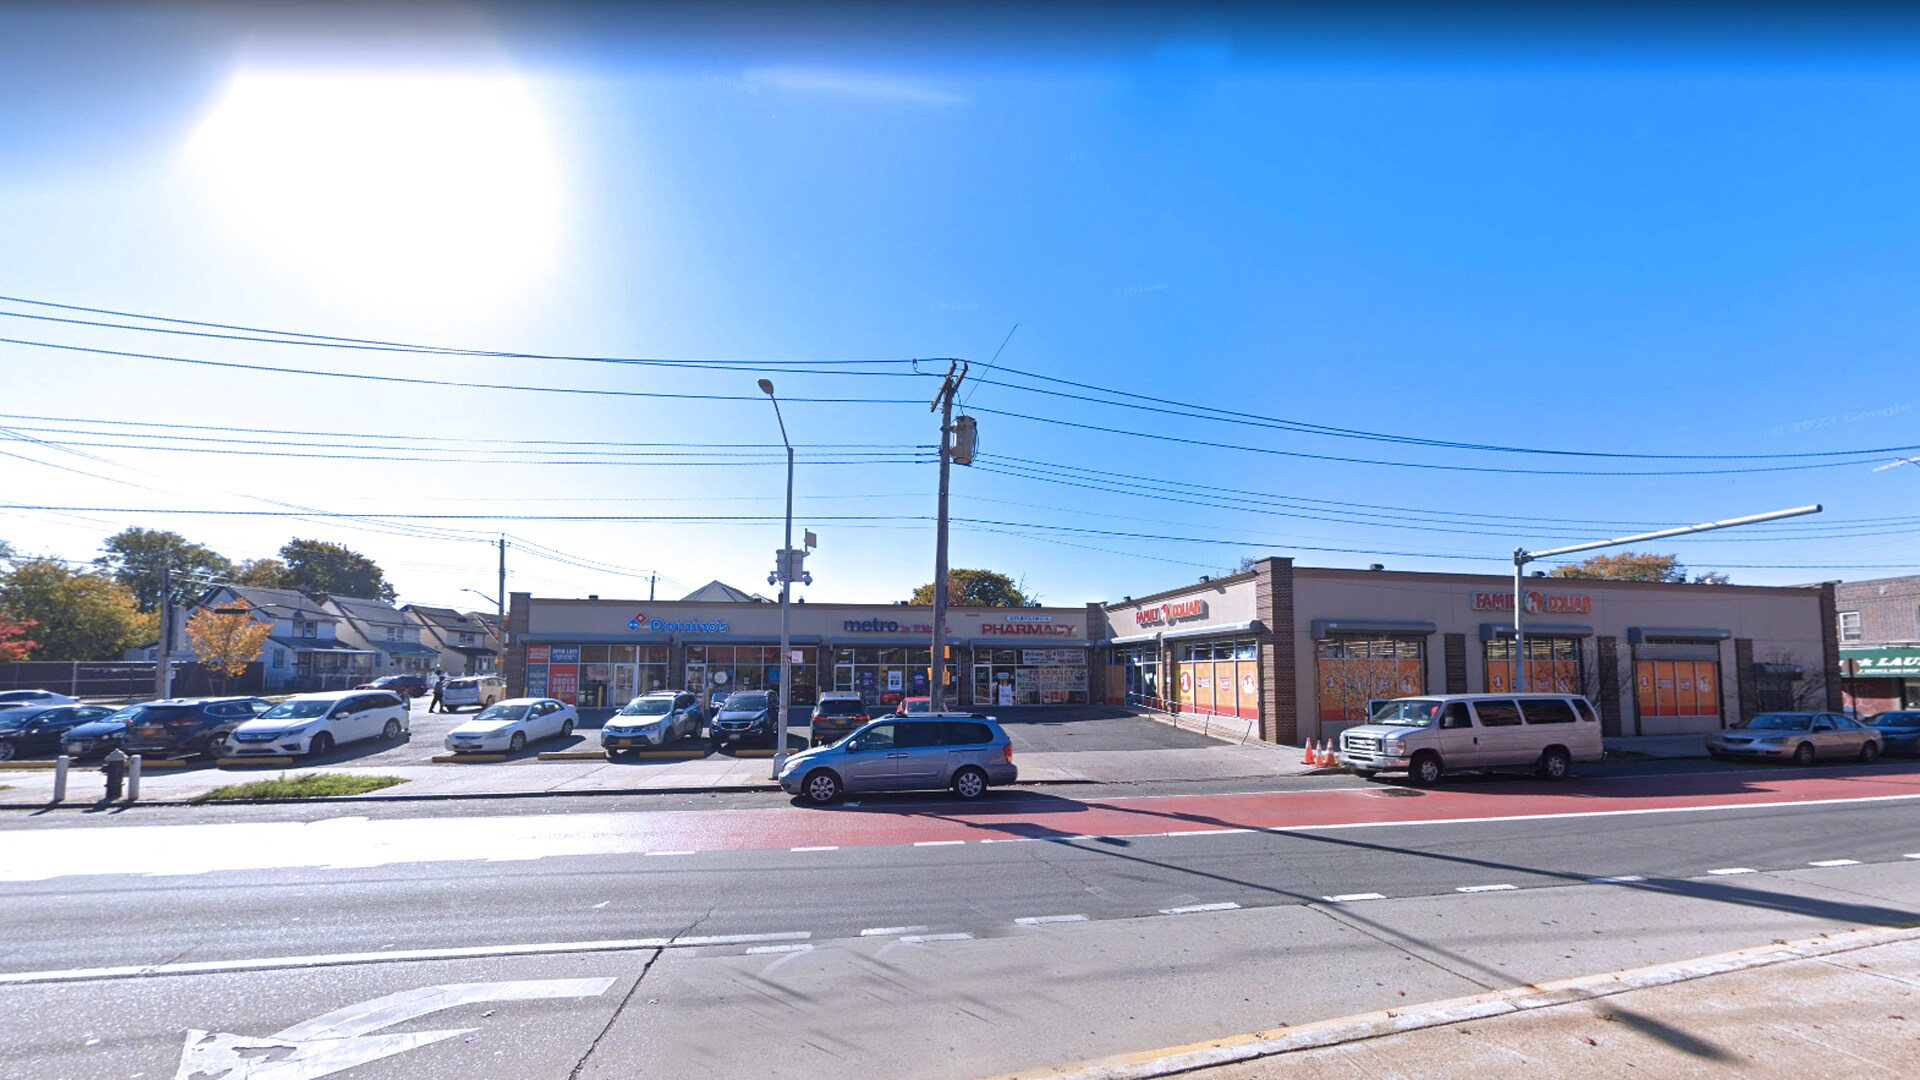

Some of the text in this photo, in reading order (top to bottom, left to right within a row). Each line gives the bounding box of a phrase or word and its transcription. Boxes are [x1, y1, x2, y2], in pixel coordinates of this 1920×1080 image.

[1476, 592, 1593, 612] FAMIL DOLLAR
[1136, 599, 1201, 624] FAMILY DOLLAR
[650, 617, 729, 633] Domino's
[843, 617, 899, 632] metro
[981, 623, 1076, 636] PHARMACY
[1876, 657, 1920, 667] LAU
